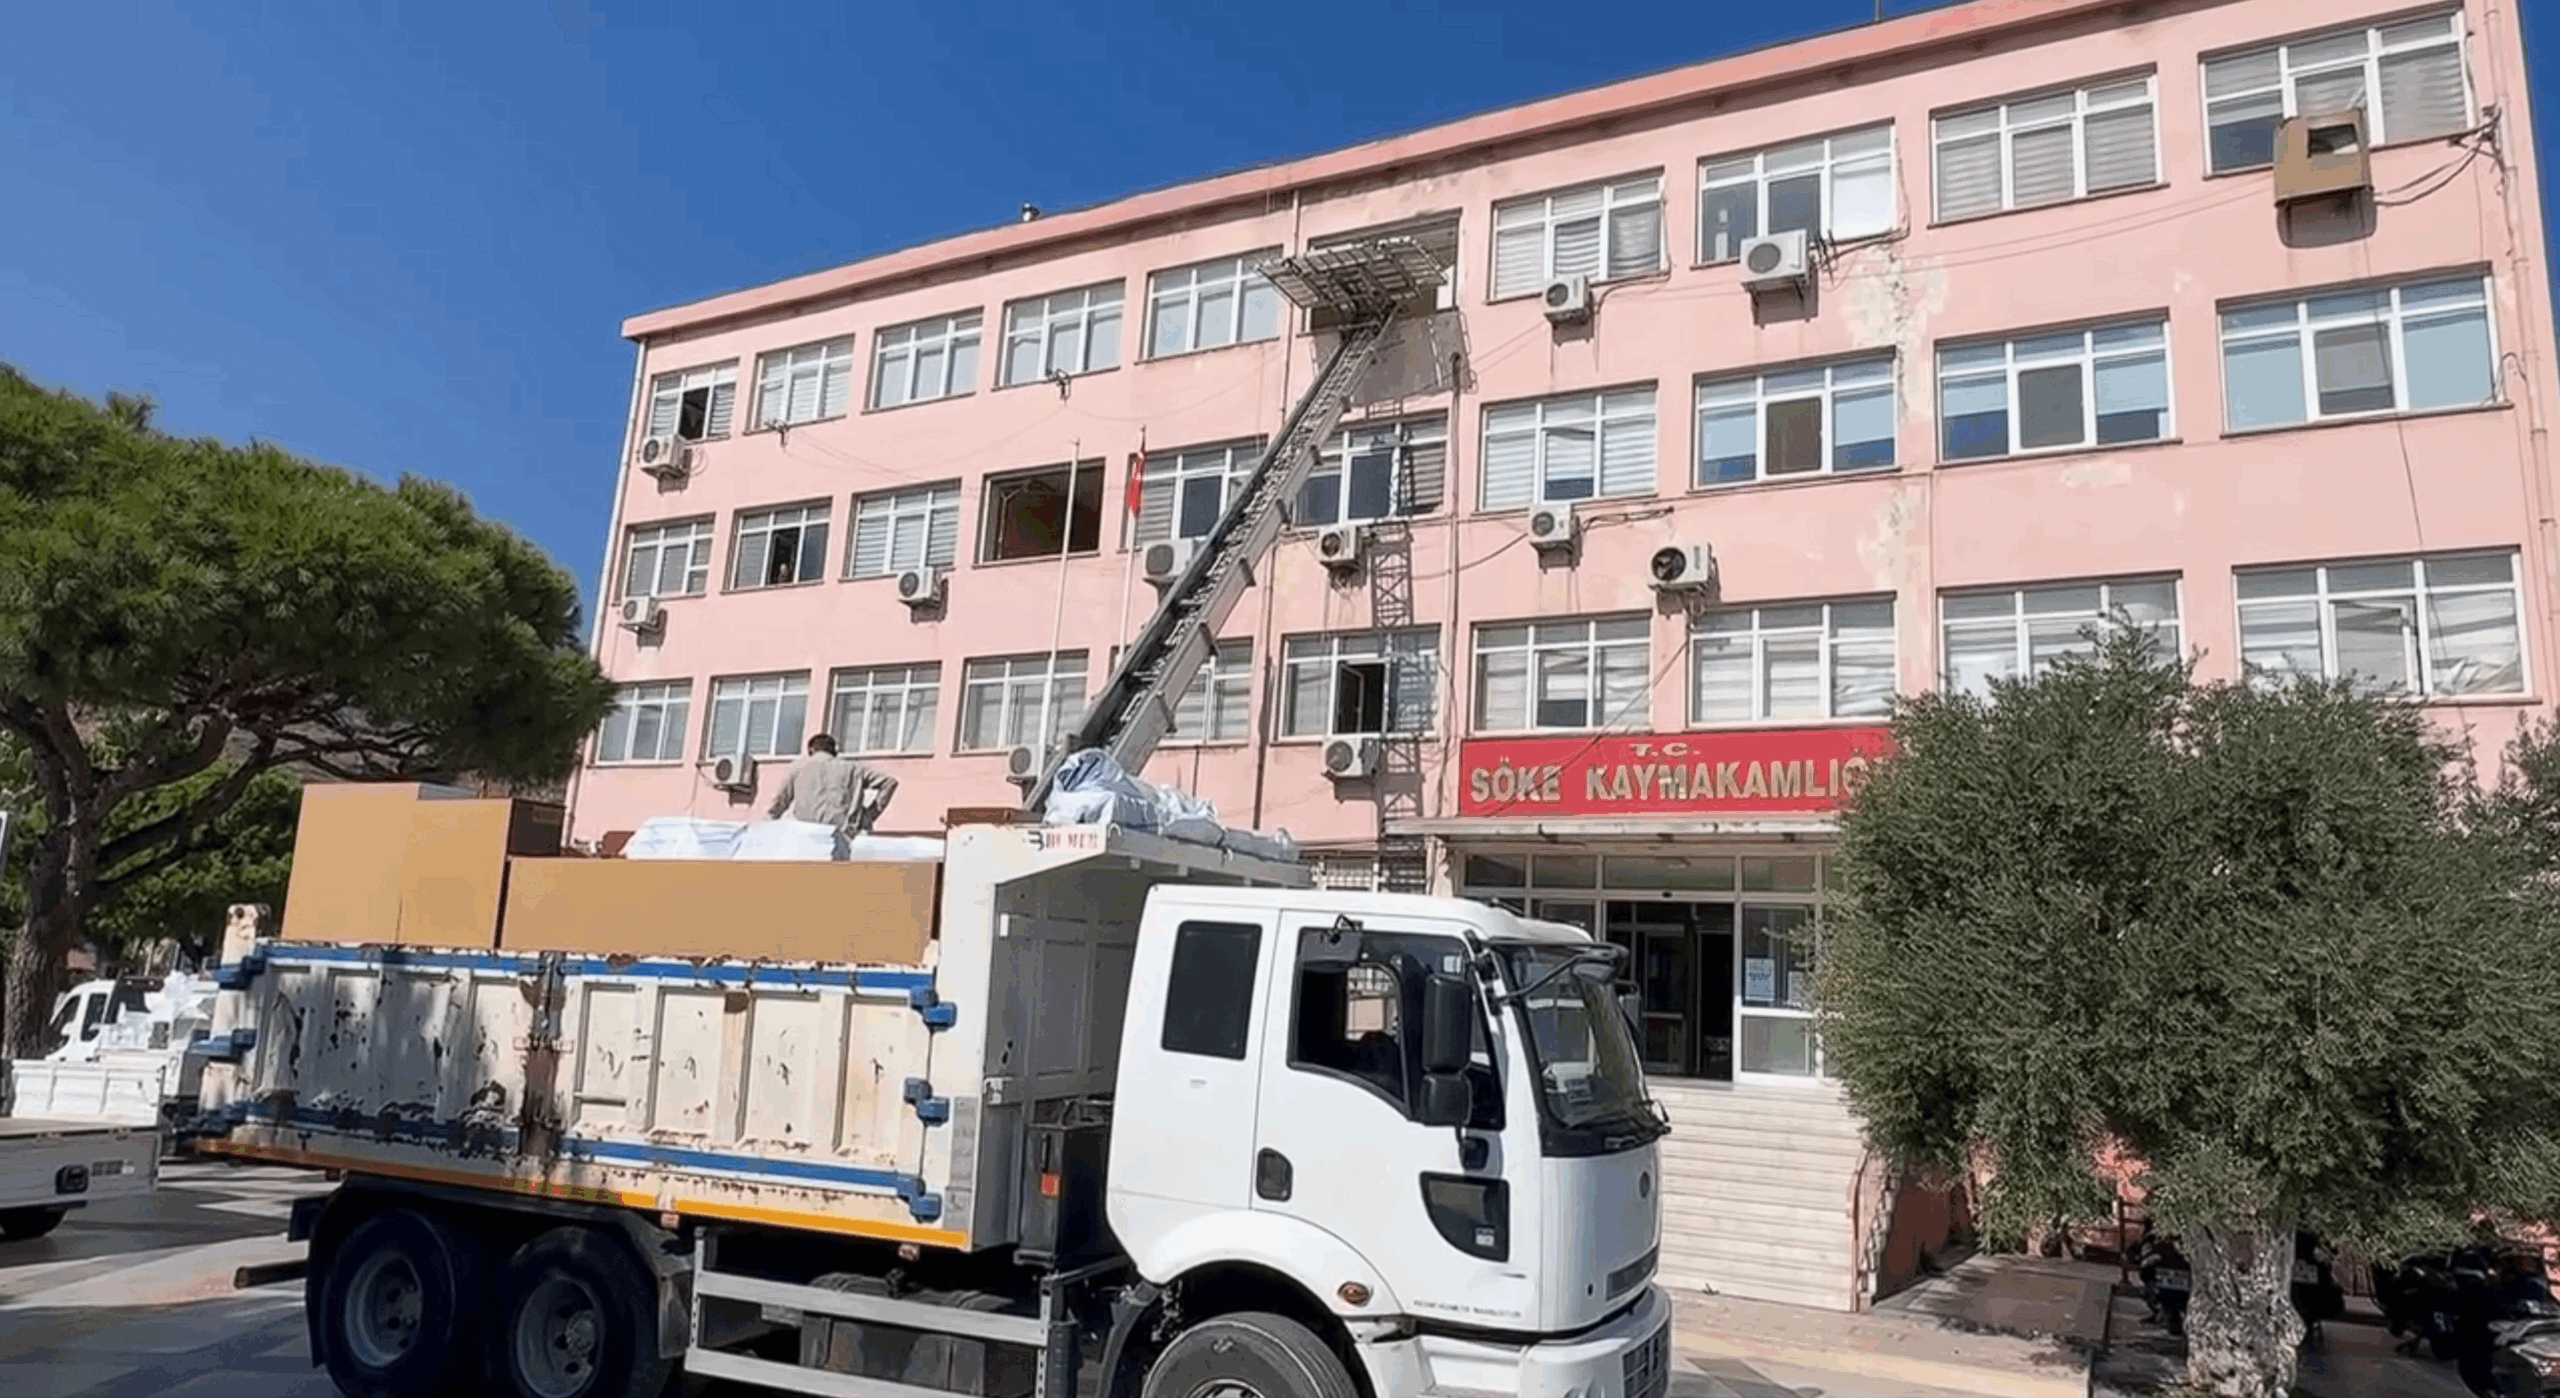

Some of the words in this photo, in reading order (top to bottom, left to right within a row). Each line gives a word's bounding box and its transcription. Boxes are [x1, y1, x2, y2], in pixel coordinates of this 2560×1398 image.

[1629, 743, 1701, 757] T.C.
[1470, 757, 1562, 802] SÖKE
[1586, 746, 1884, 800] KAYMAKAMLIĞ
